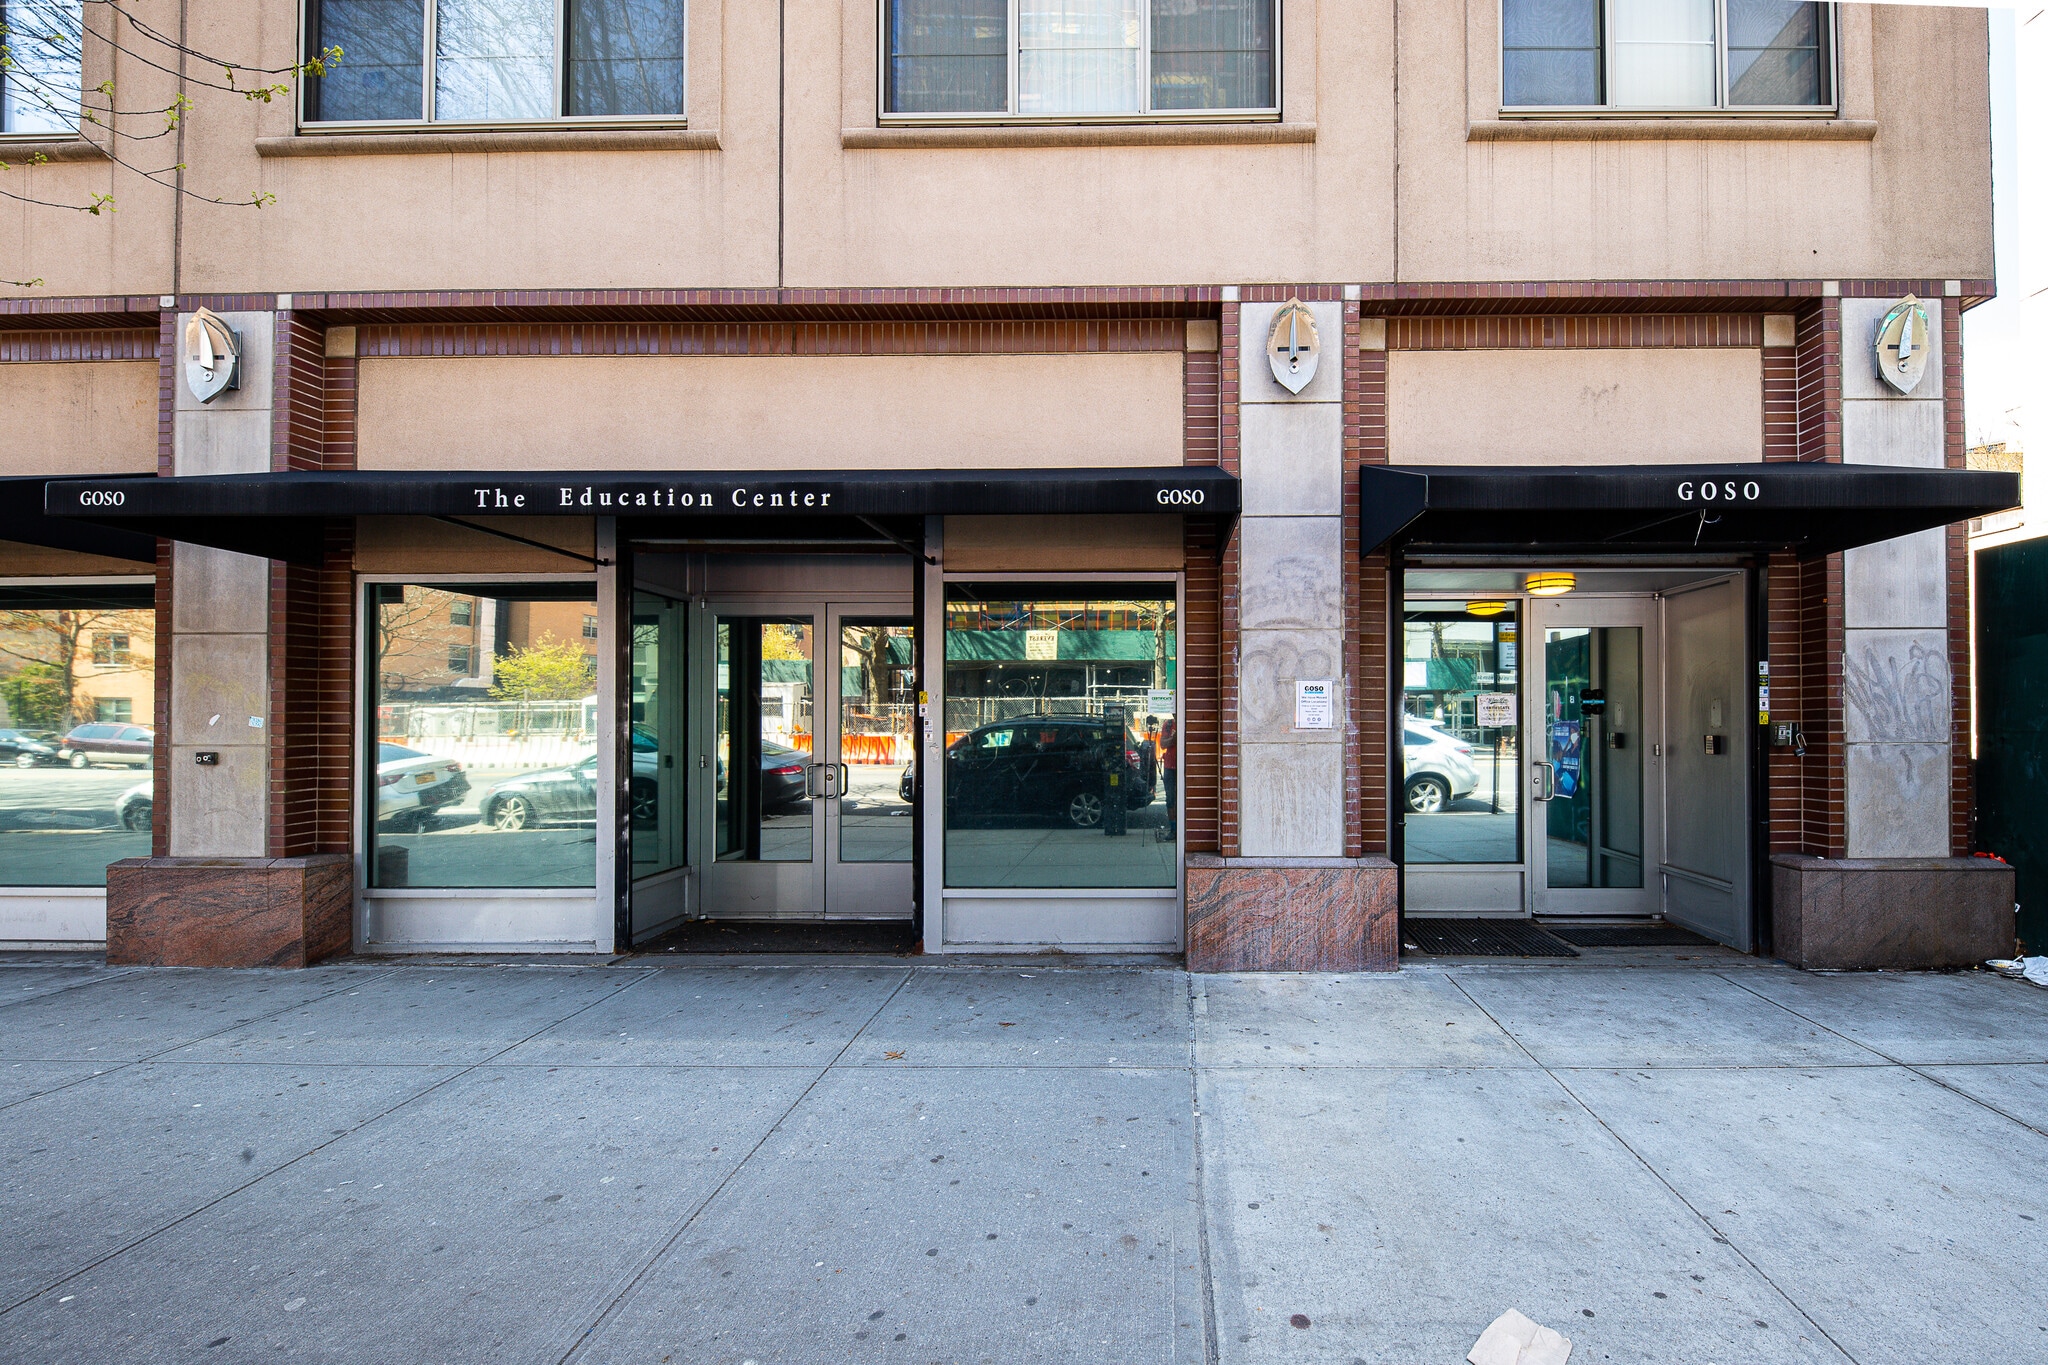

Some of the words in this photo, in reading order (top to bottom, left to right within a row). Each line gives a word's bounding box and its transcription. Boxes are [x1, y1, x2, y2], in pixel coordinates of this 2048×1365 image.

[79, 490, 126, 506] GOSO
[474, 487, 526, 508] The
[558, 486, 714, 507] Education
[731, 488, 832, 507] Center
[1156, 489, 1205, 505] GOSO
[1677, 481, 1761, 501] GOSO
